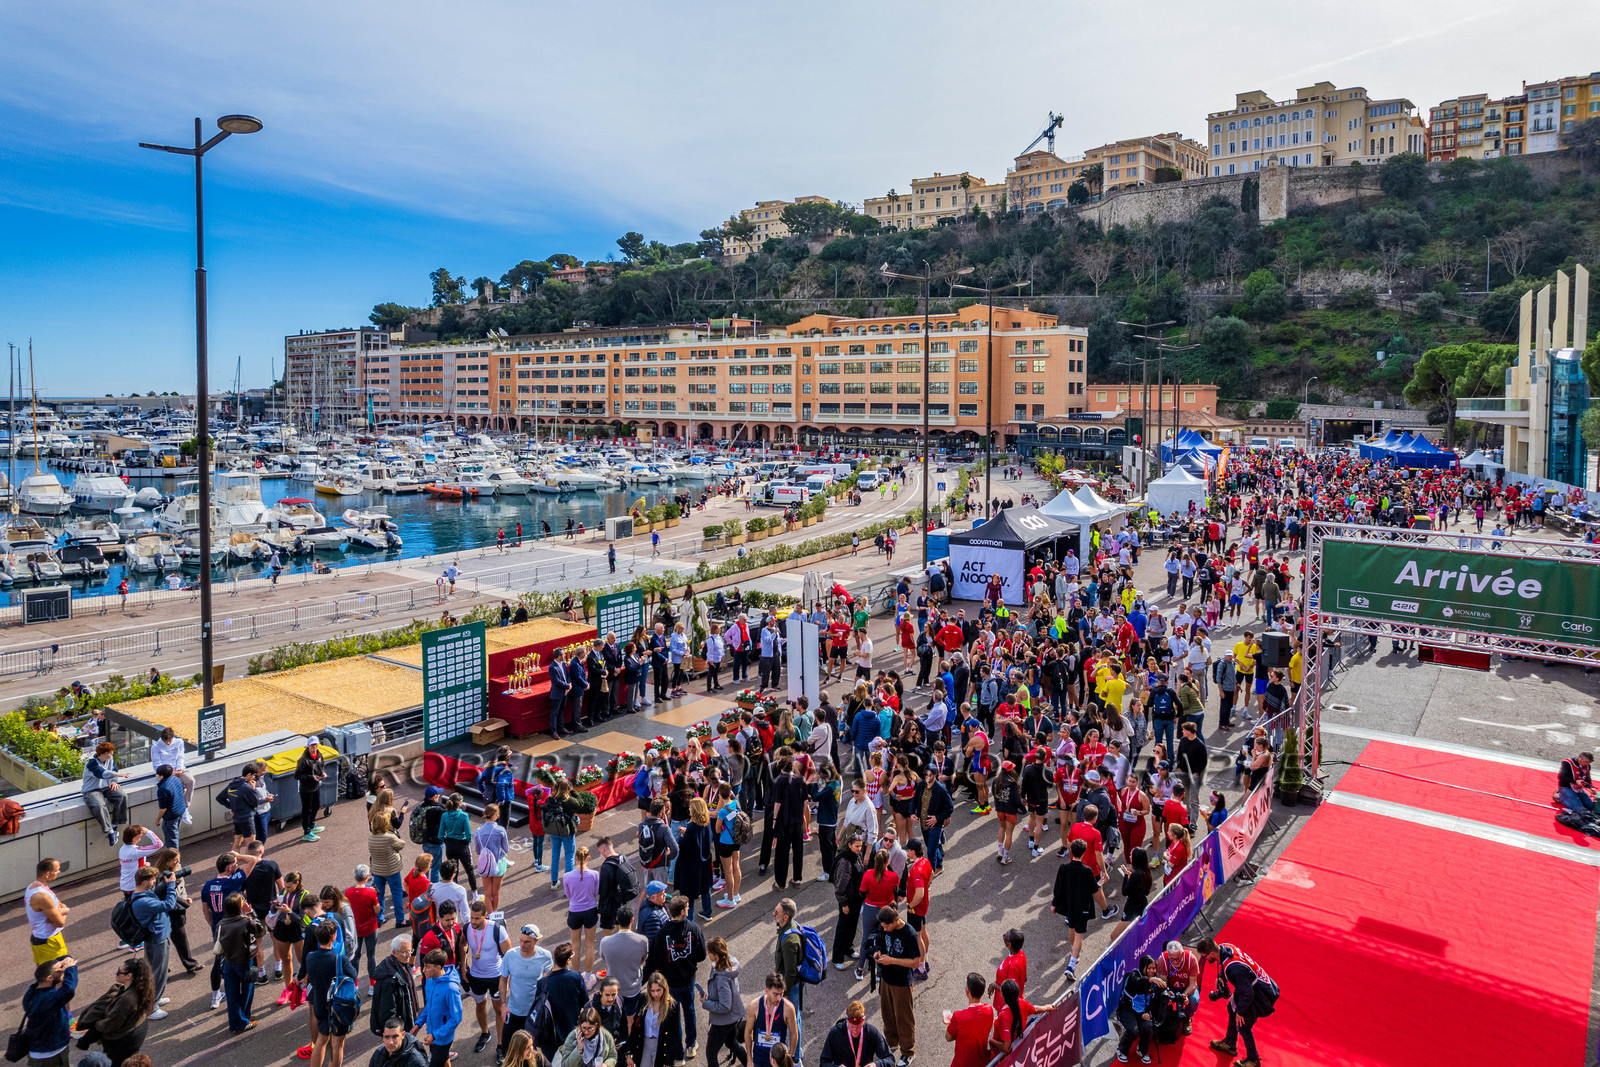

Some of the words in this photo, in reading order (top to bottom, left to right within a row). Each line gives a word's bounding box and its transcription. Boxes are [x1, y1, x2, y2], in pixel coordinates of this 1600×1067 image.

[962, 560, 986, 572] ACT
[1394, 560, 1542, 599] Arrivée
[1393, 602, 1416, 611] 42K
[1454, 608, 1491, 619] MONAFRAIS
[1561, 621, 1593, 633] Carlo
[210, 892, 223, 912] 17
[1134, 939, 1148, 959] SHOP
[1178, 891, 1195, 911] LOCAL
